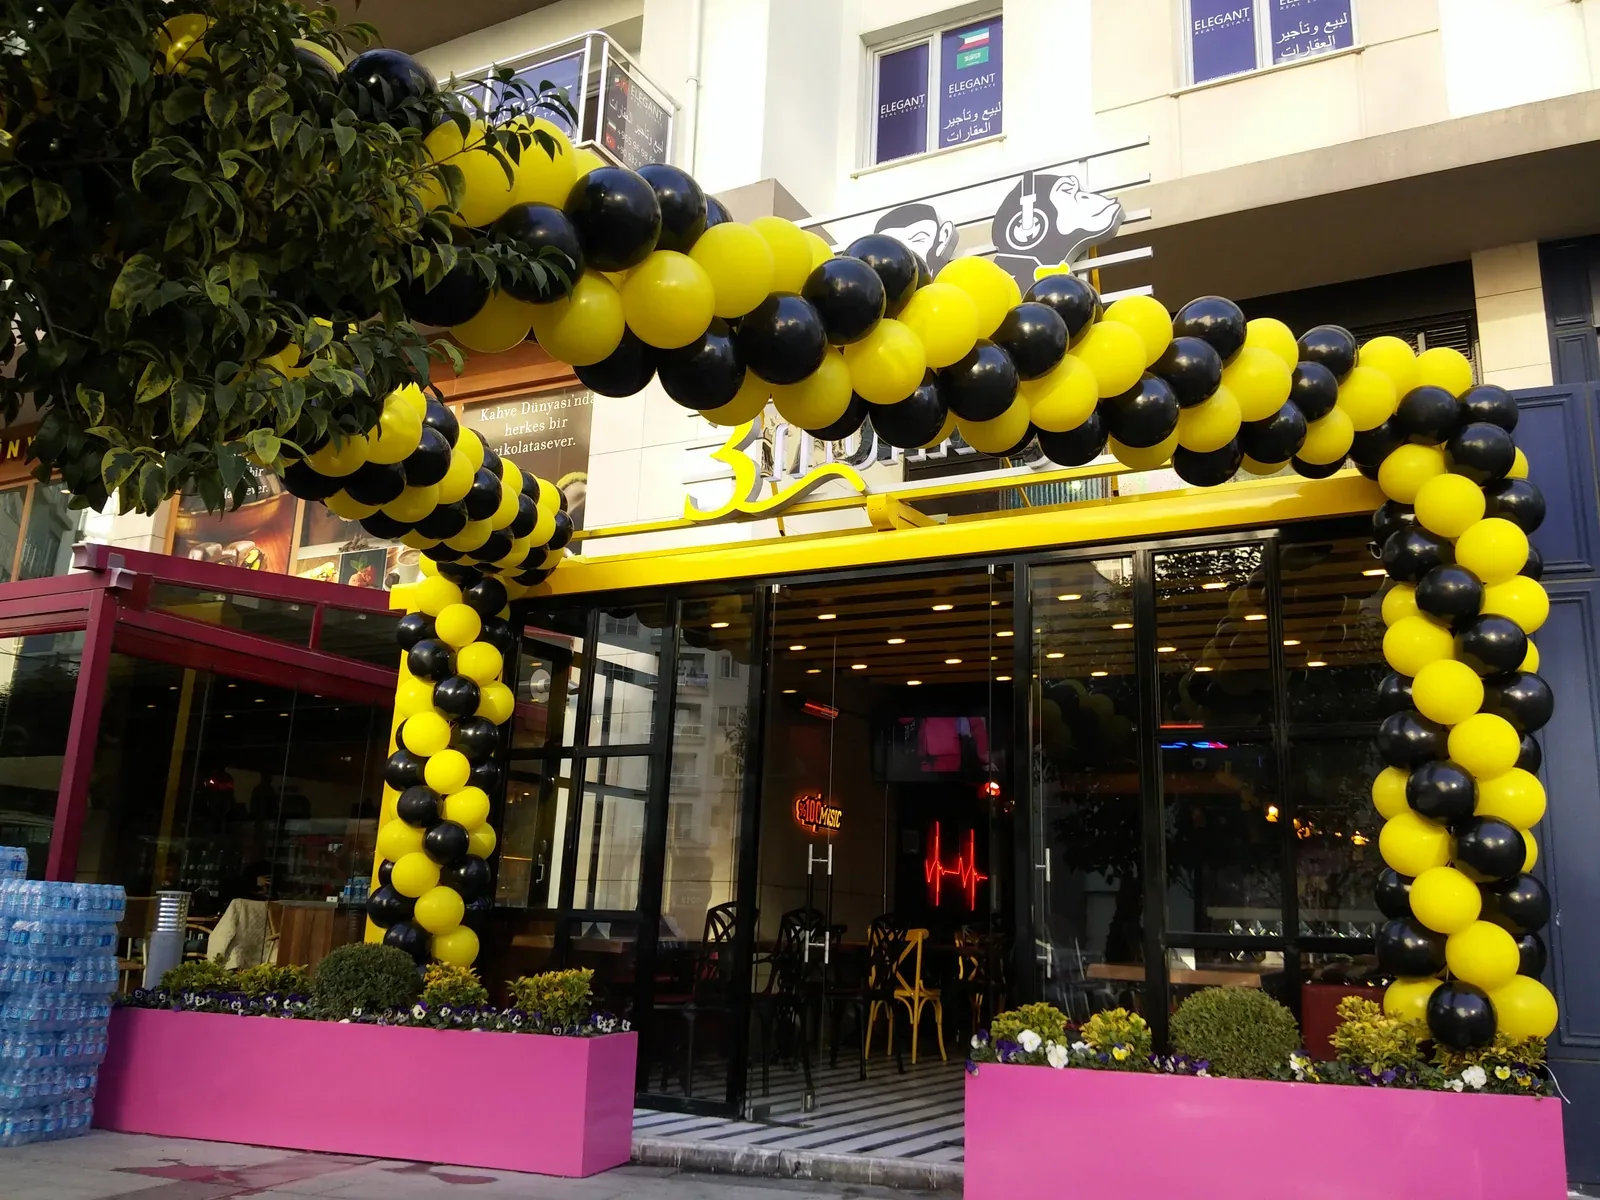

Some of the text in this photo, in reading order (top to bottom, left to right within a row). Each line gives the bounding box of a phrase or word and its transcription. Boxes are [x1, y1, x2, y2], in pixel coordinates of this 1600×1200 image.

[1194, 7, 1250, 31] ELEGANT
[1323, 12, 1348, 33] لبيع
[1281, 35, 1336, 57] العقارات
[948, 73, 996, 94] ELEGANT
[630, 85, 664, 122] ELEGANT
[880, 94, 926, 114] ELEGANT
[982, 101, 1002, 121] لبيع
[946, 122, 991, 142] العقارات
[480, 406, 517, 422] Kahve
[504, 417, 568, 437] herkes bir
[818, 806, 843, 829] MUSIC
